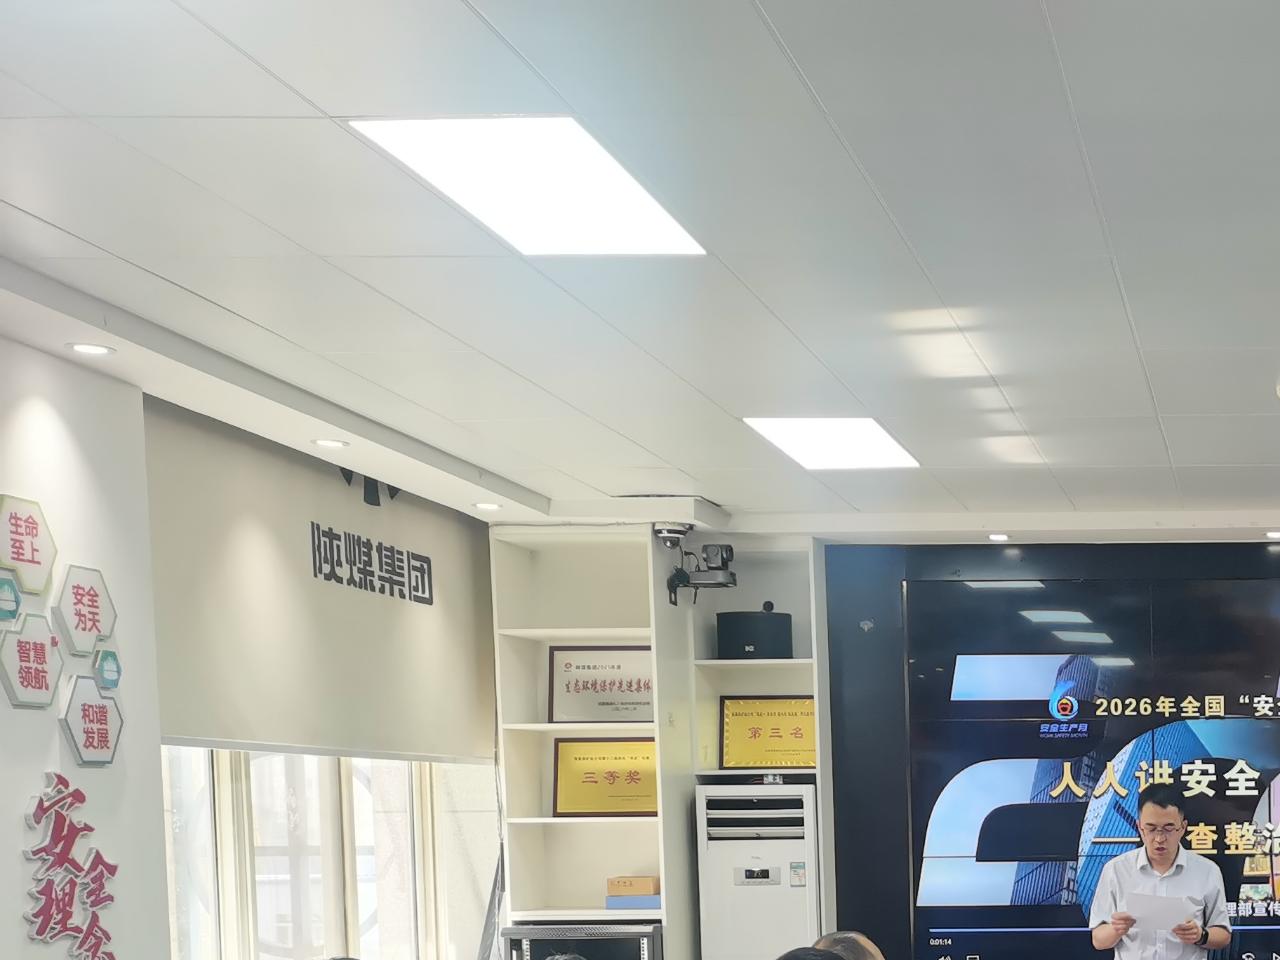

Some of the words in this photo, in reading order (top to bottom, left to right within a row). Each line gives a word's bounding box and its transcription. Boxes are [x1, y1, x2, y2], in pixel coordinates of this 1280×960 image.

[9, 512, 39, 538] 生命
[10, 538, 41, 565] 至上
[311, 521, 434, 605] 陕煤集团
[72, 584, 99, 611] 安全
[75, 609, 101, 634] 为天
[17, 639, 47, 665] 智慧
[19, 665, 49, 691] 领航
[81, 702, 109, 726] 和谐
[83, 726, 110, 750] 发展
[748, 726, 805, 740] 第三名
[1040, 723, 1088, 733] 安全生产月
[582, 769, 641, 785] 三等奖
[1050, 759, 1261, 798] 人人讲安全
